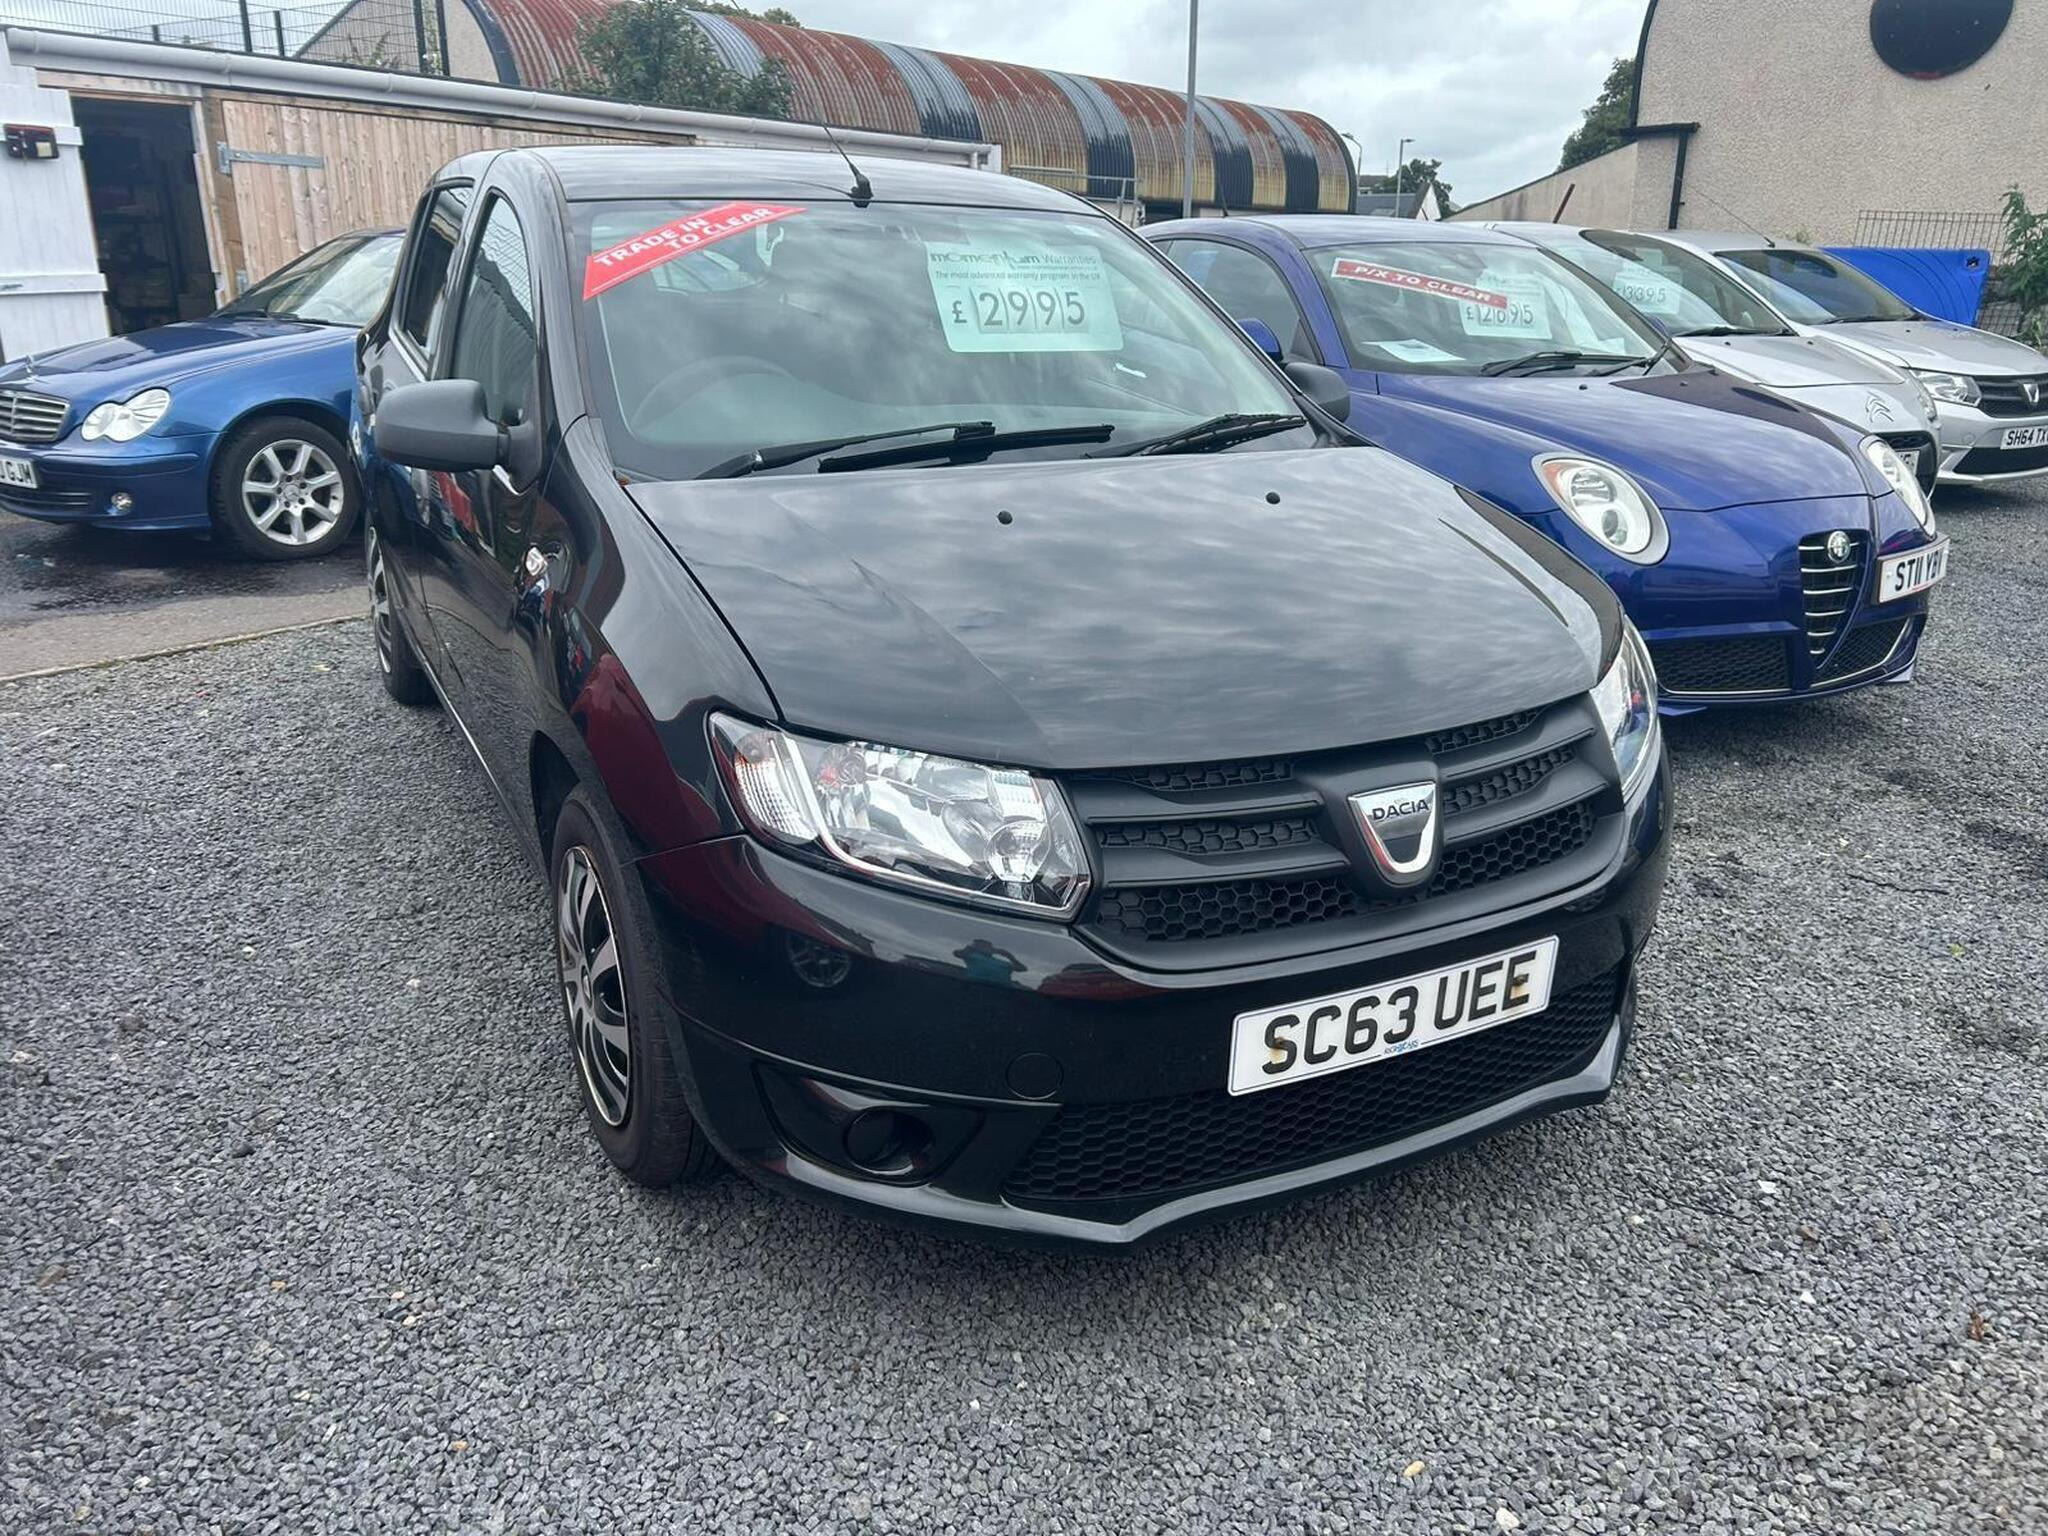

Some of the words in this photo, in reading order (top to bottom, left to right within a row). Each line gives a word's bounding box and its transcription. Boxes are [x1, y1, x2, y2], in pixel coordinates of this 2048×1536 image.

[594, 229, 678, 266] TRADE
[678, 217, 710, 233] IN
[664, 234, 700, 250] TO
[703, 208, 775, 235] CLEAR
[1354, 266, 1389, 279] P/X
[1394, 273, 1420, 285] TO
[1427, 280, 1491, 301] CLEAR
[952, 300, 967, 323] £
[979, 291, 1085, 326] 2995
[1466, 306, 1474, 320] £
[2007, 429, 2035, 446] SH64
[2037, 428, 2048, 443] TX
[1372, 799, 1429, 820] DACIA
[1262, 985, 1419, 1075] SC63
[1434, 950, 1537, 1031] UEE
